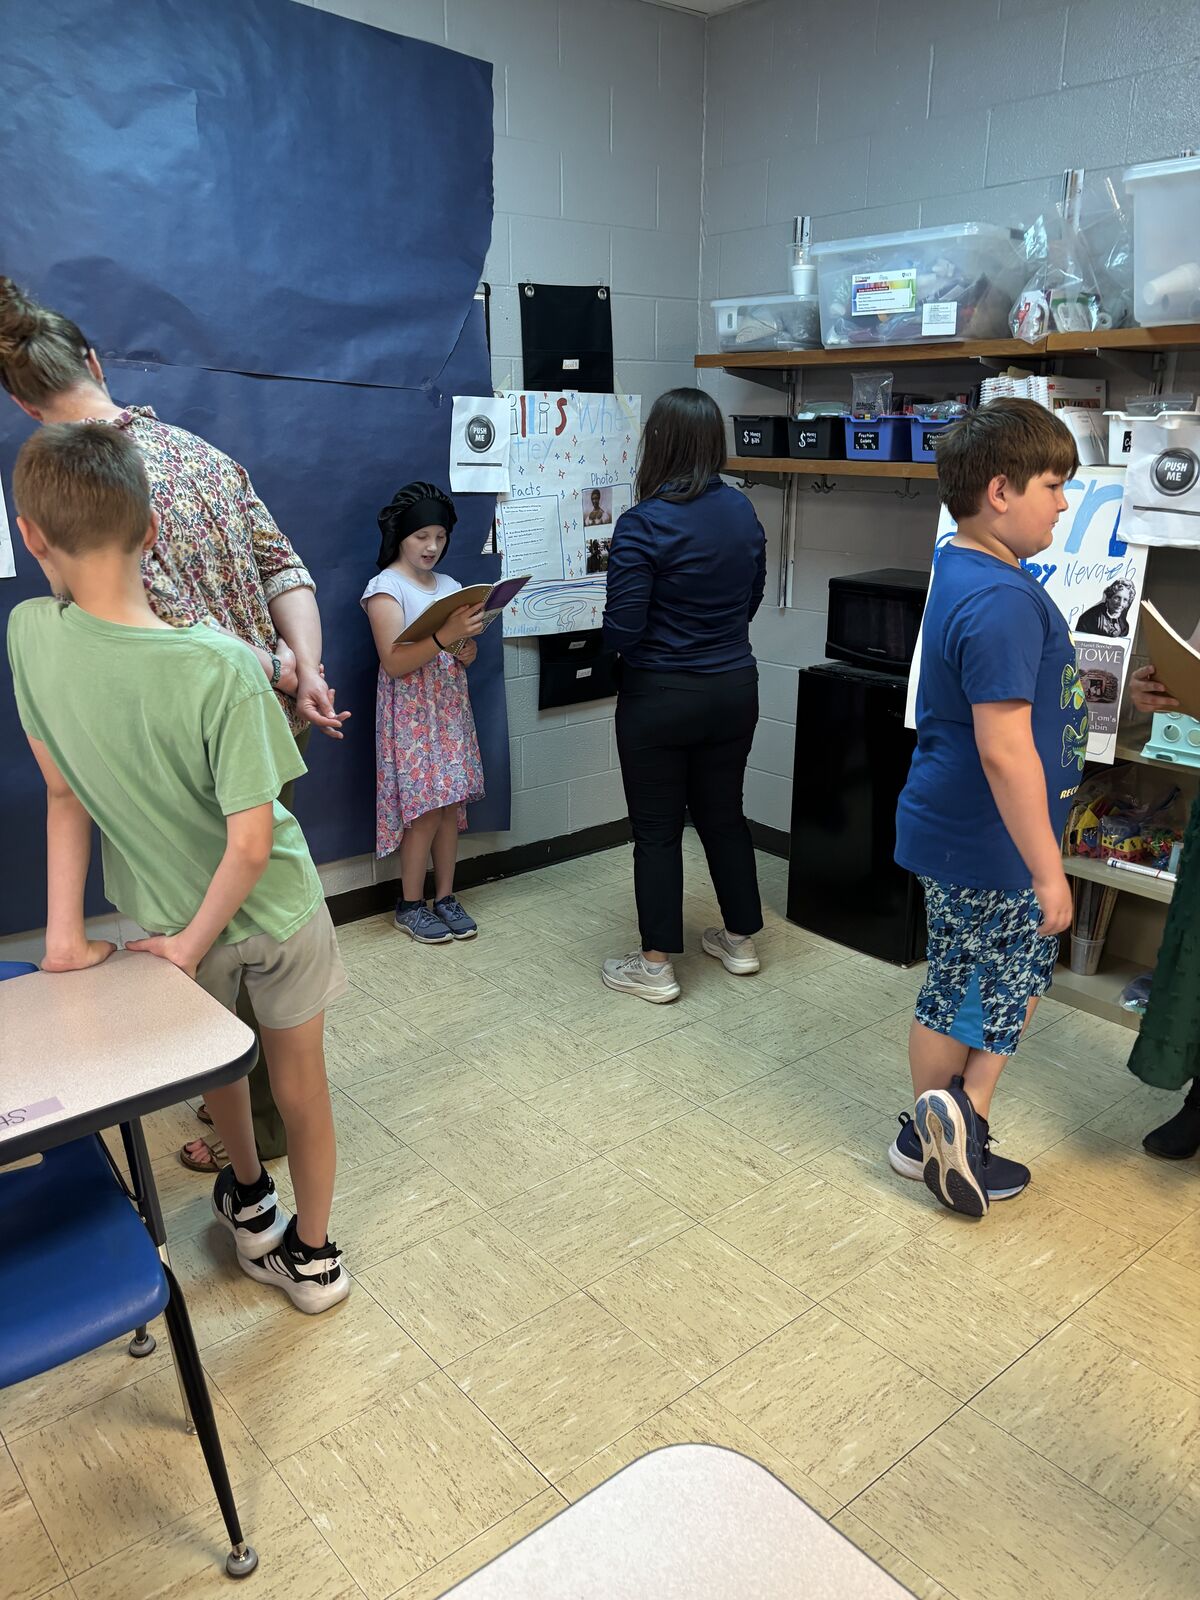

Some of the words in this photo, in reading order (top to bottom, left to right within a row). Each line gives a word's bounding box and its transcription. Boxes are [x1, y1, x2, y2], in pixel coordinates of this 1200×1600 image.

[508, 393, 567, 438] illis
[473, 426, 487, 435] PUSH
[475, 434, 486, 442] ME
[1164, 461, 1188, 472] PUSH
[1166, 472, 1182, 482] ME
[511, 483, 541, 497] Facts
[1077, 647, 1122, 664] TOWE
[1088, 710, 1116, 723] Tom's
[1089, 721, 1108, 731] abin
